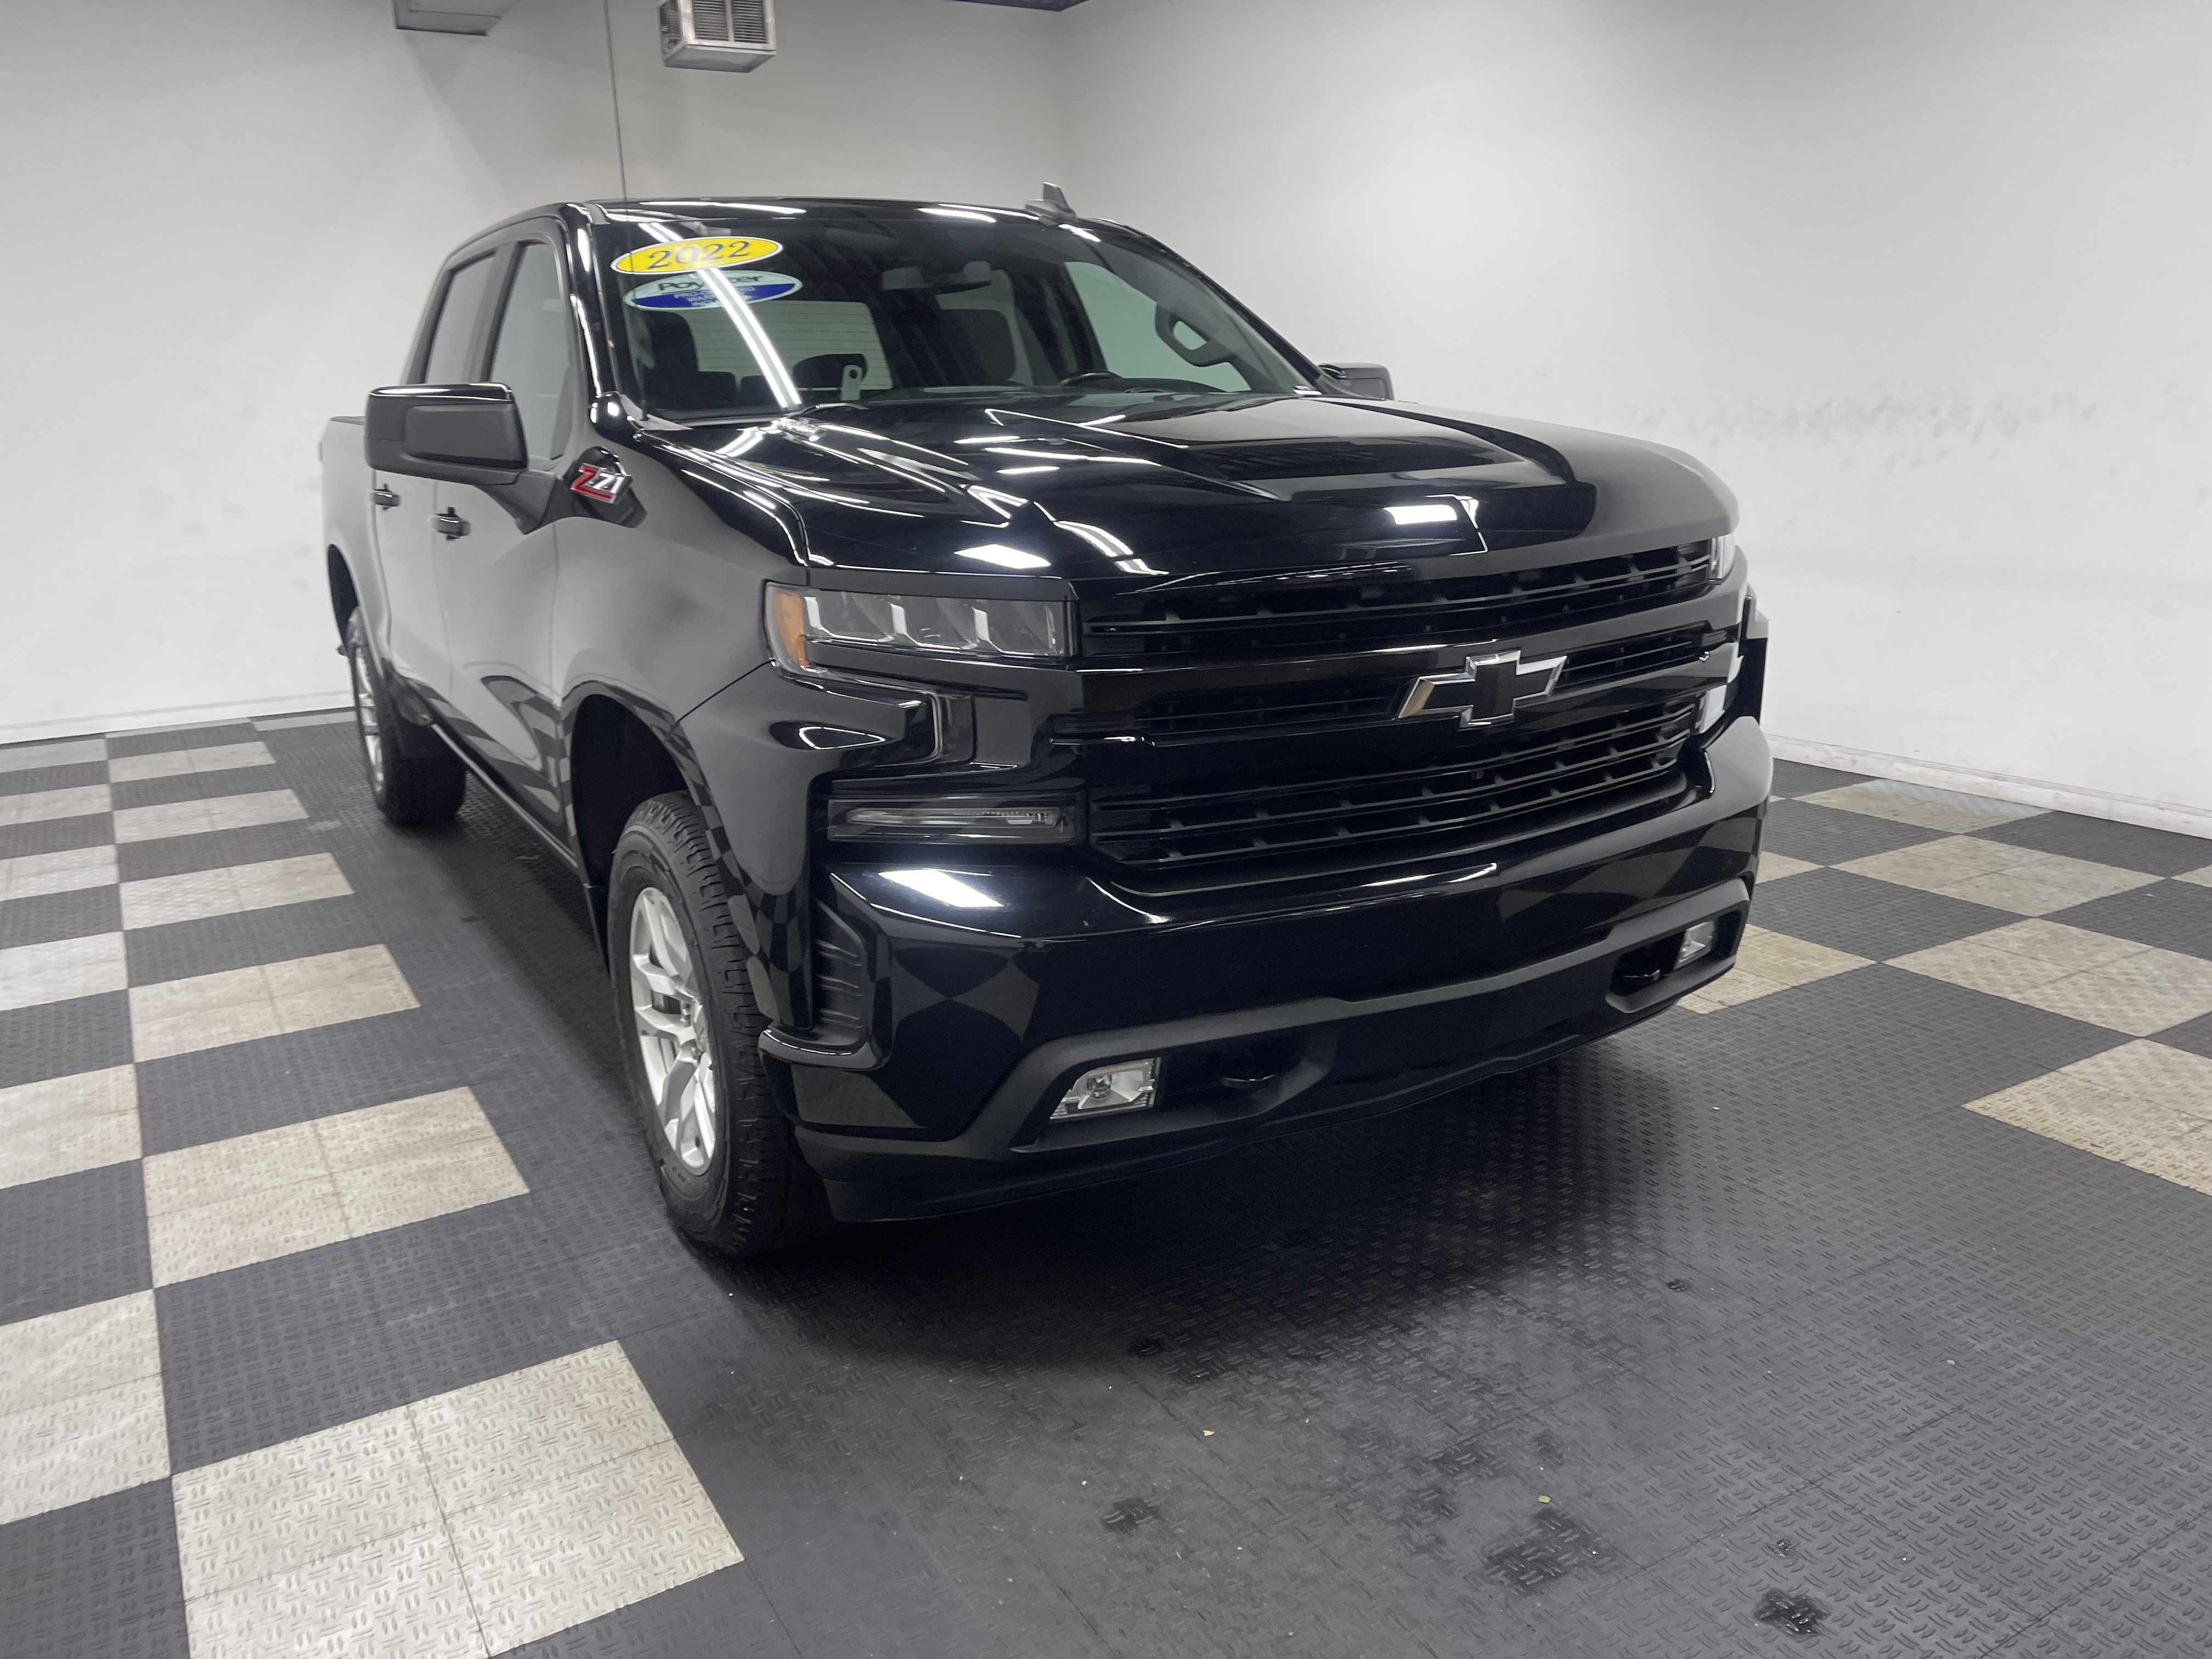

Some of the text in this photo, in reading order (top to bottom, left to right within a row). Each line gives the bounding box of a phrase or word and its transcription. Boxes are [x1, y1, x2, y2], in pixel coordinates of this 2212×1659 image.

[647, 241, 751, 269] 2022
[658, 275, 764, 294] Poyter
[571, 463, 627, 504] Z71
